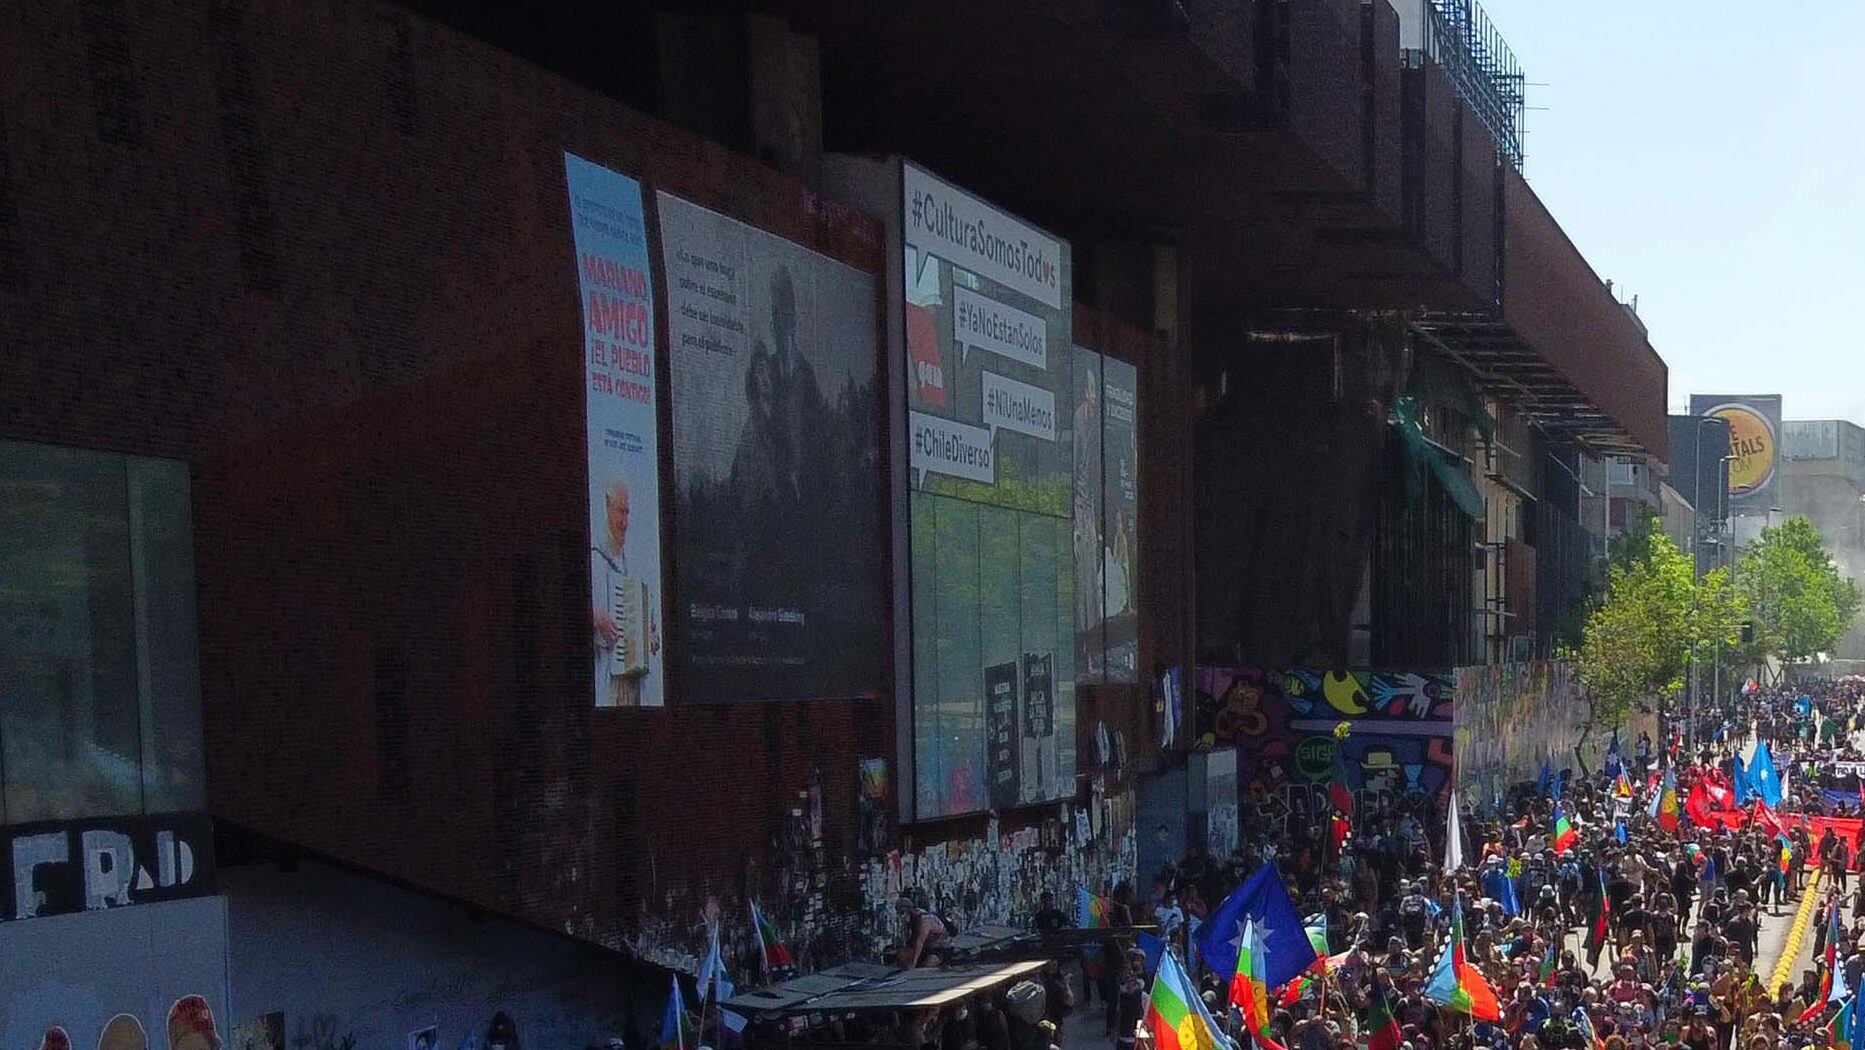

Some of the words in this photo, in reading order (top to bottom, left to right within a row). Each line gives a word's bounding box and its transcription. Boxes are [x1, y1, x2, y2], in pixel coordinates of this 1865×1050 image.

[590, 291, 648, 348] AMIGO
[959, 301, 1043, 356] #YaNoEstanSolos
[987, 388, 1052, 430] #NiUnaMenos
[915, 425, 990, 468] #ChileDiverso
